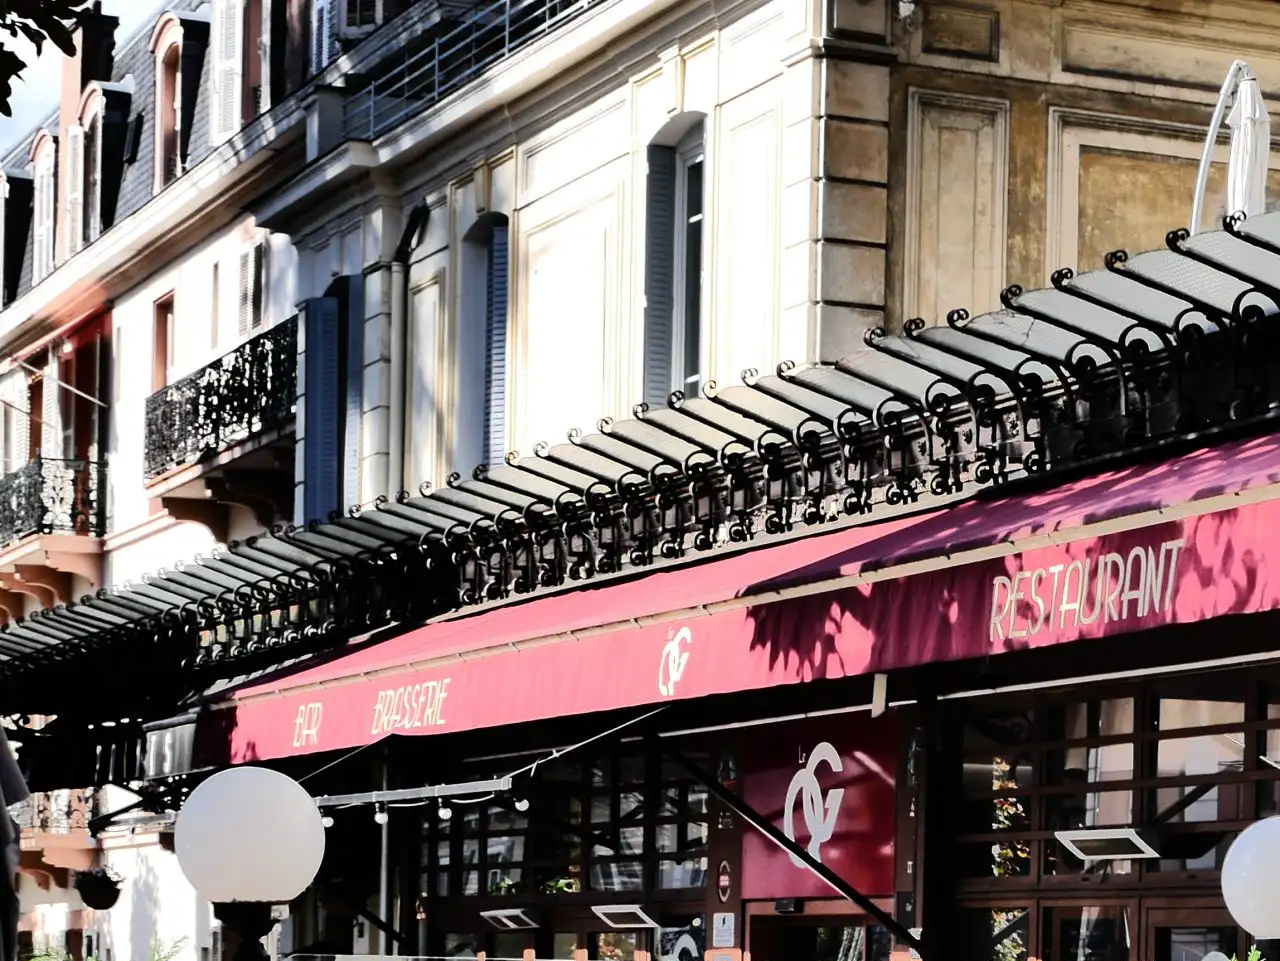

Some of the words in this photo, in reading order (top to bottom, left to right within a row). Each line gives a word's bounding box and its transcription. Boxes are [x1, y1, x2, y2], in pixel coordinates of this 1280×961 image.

[990, 539, 1184, 641] RESTAURANT
[292, 702, 323, 747] BAR
[371, 678, 451, 735] BRASSERIE
